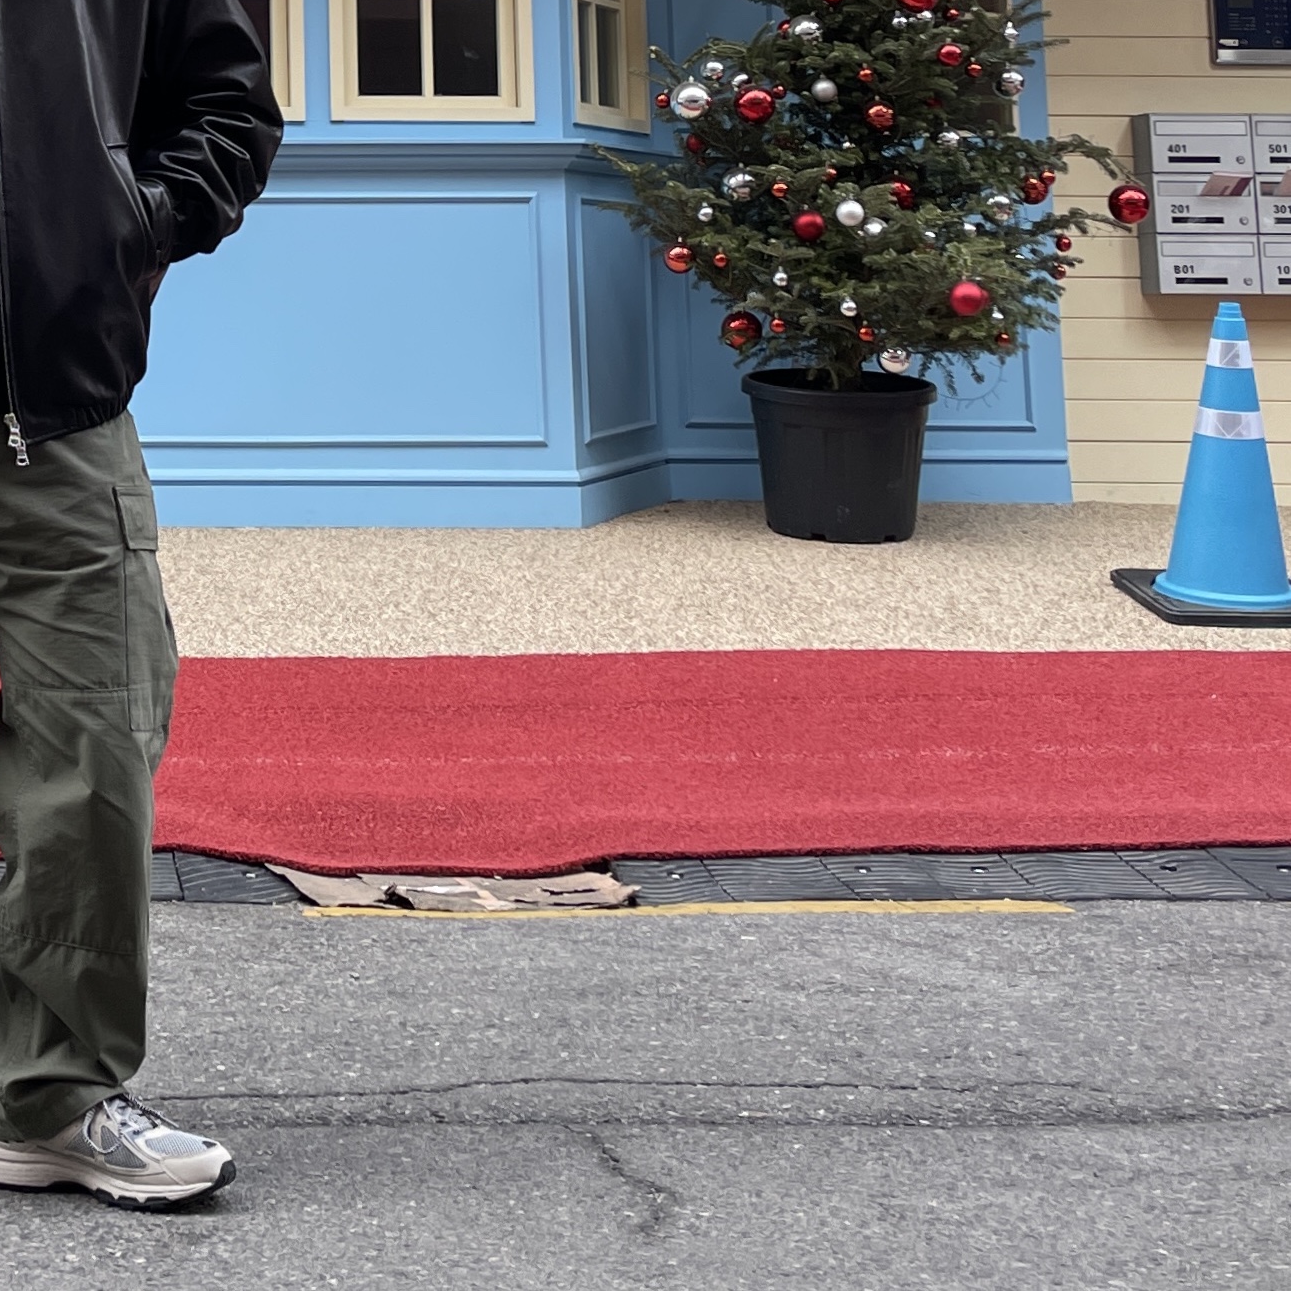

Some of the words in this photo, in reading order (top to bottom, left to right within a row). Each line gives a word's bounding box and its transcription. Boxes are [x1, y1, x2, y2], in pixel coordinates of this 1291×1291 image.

[1167, 143, 1187, 154] 401
[1268, 143, 1288, 154] 501
[1170, 204, 1190, 214] 201
[1173, 265, 1195, 275] B01
[1277, 265, 1291, 275] 10
